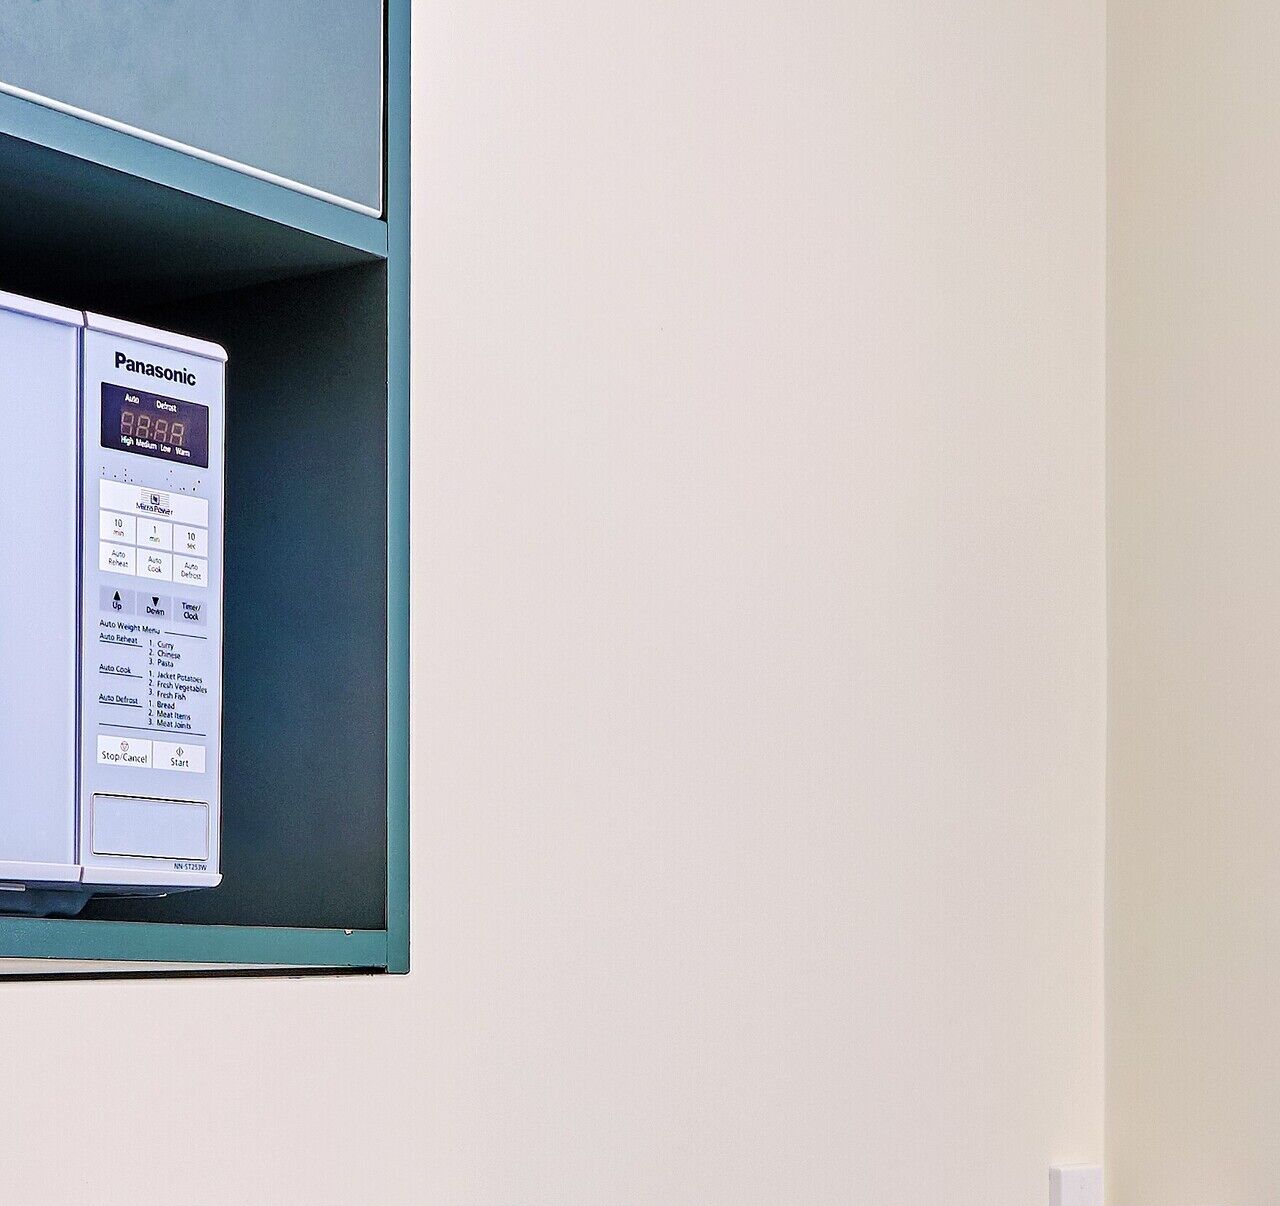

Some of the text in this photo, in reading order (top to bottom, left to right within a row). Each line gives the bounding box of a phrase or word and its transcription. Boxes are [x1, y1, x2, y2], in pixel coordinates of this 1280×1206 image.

[115, 351, 196, 386] Panasonic
[125, 393, 140, 404] Auto
[156, 400, 177, 413] Defrost
[120, 435, 134, 446] High
[135, 439, 158, 450] Medium
[160, 444, 172, 453] Low
[114, 518, 123, 528] 10
[187, 532, 196, 541] 10
[111, 549, 126, 559] Auto
[108, 558, 129, 568] Reheat
[148, 555, 162, 565] Auto
[147, 564, 162, 574] Cook
[184, 562, 199, 571] Auto
[180, 570, 202, 581] Defrost
[112, 601, 122, 611] Up
[146, 606, 165, 616] Down
[182, 601, 201, 611] Timer/
[183, 611, 199, 621] Clock
[99, 619, 160, 635] Auto Weight Menu
[99, 632, 138, 644] Auto Reheat
[157, 641, 174, 651] Curry
[157, 650, 181, 660] Chinese
[99, 663, 131, 674] Auto Cook
[157, 659, 174, 668] Pasta
[157, 671, 176, 681] Jacket
[177, 673, 203, 684] Potatoes
[157, 681, 173, 689] Fresh
[175, 682, 208, 694] Vegetables
[99, 693, 138, 705] Auto Defrost
[157, 690, 173, 699] Fresh
[174, 692, 187, 701] Fish
[156, 700, 176, 710] Bread
[156, 709, 173, 719] Meat
[174, 711, 191, 721] Items
[156, 719, 173, 728] Meat
[174, 720, 192, 730] Joints
[101, 750, 148, 764] Stop/Cancel
[170, 757, 189, 768] Start
